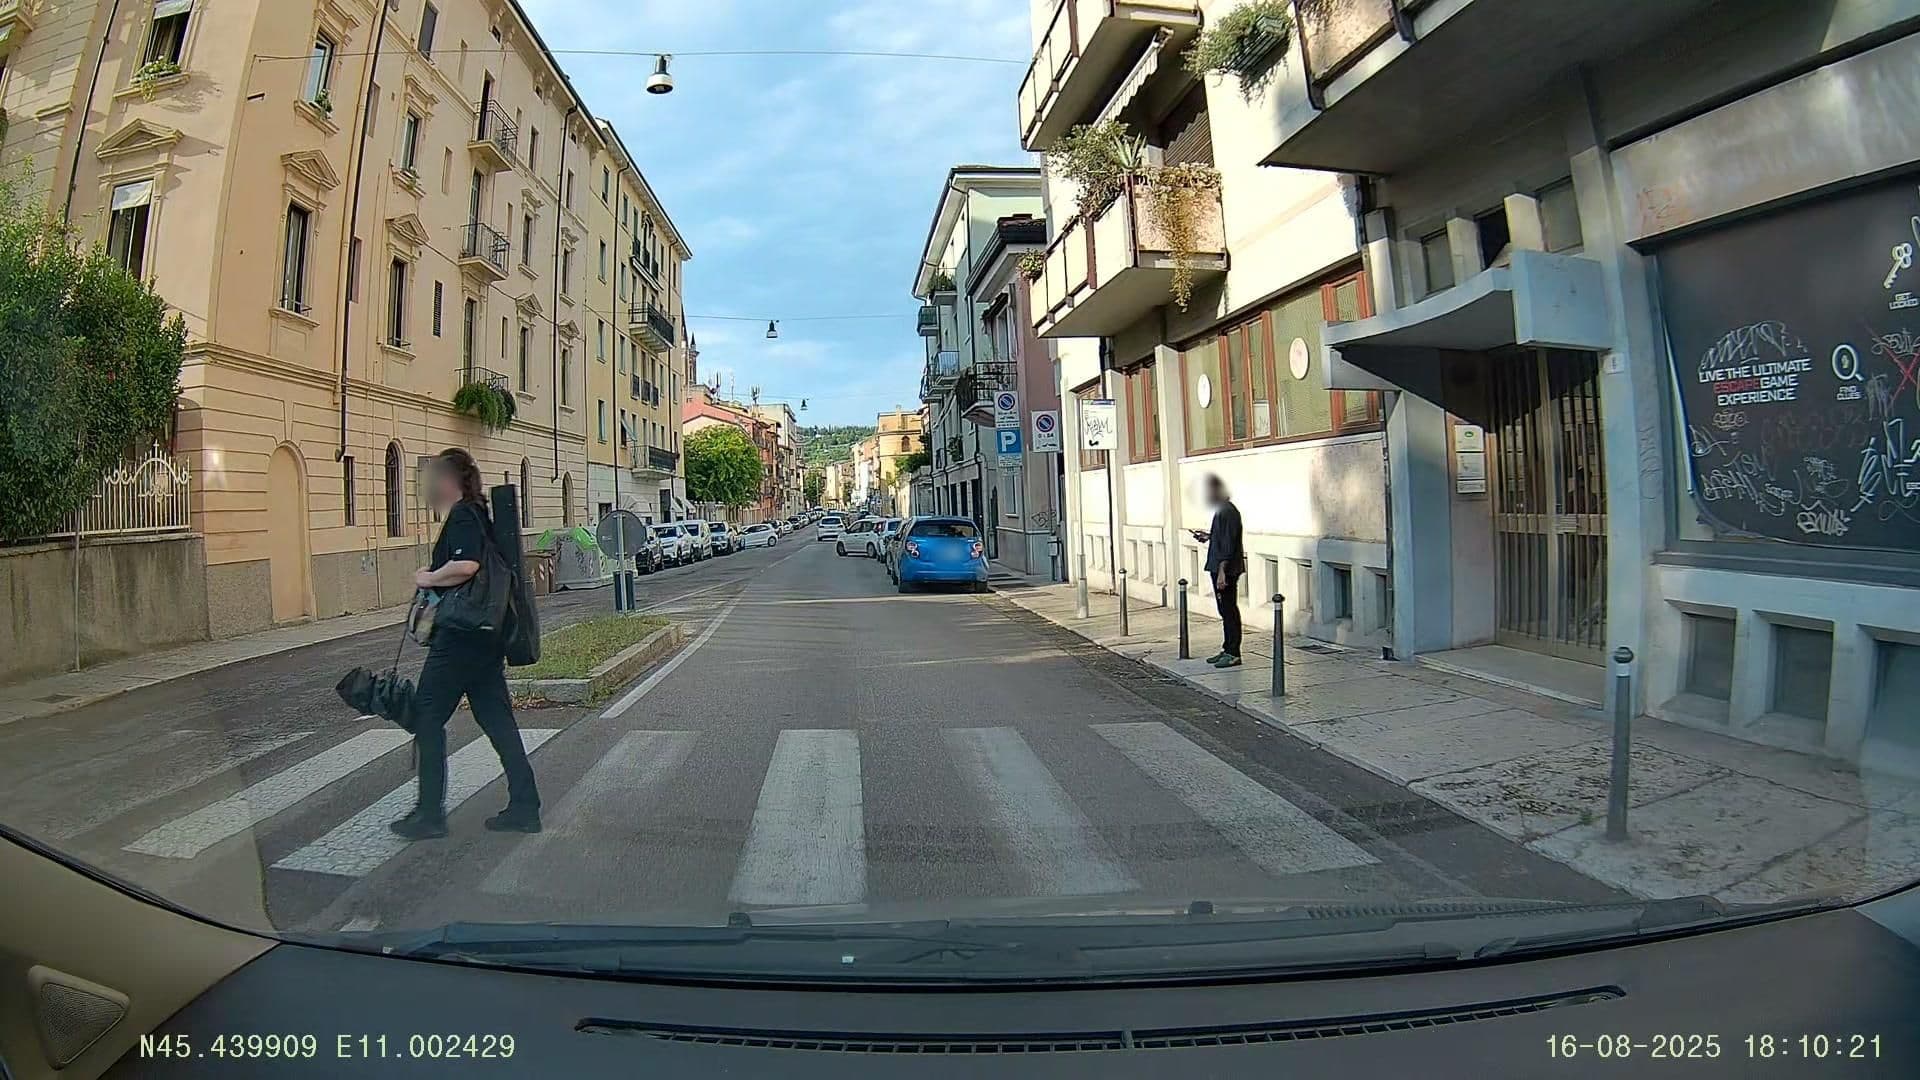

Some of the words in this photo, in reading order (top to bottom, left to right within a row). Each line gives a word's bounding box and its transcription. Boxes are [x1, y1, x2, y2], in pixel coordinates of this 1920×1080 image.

[1698, 370, 1723, 383] LIVE
[1723, 366, 1751, 379] THE
[1752, 358, 1812, 377] ULTIMATE
[1760, 374, 1799, 389] GAME
[1717, 388, 1797, 406] EXPERIENCE
[1000, 431, 1016, 452] P
